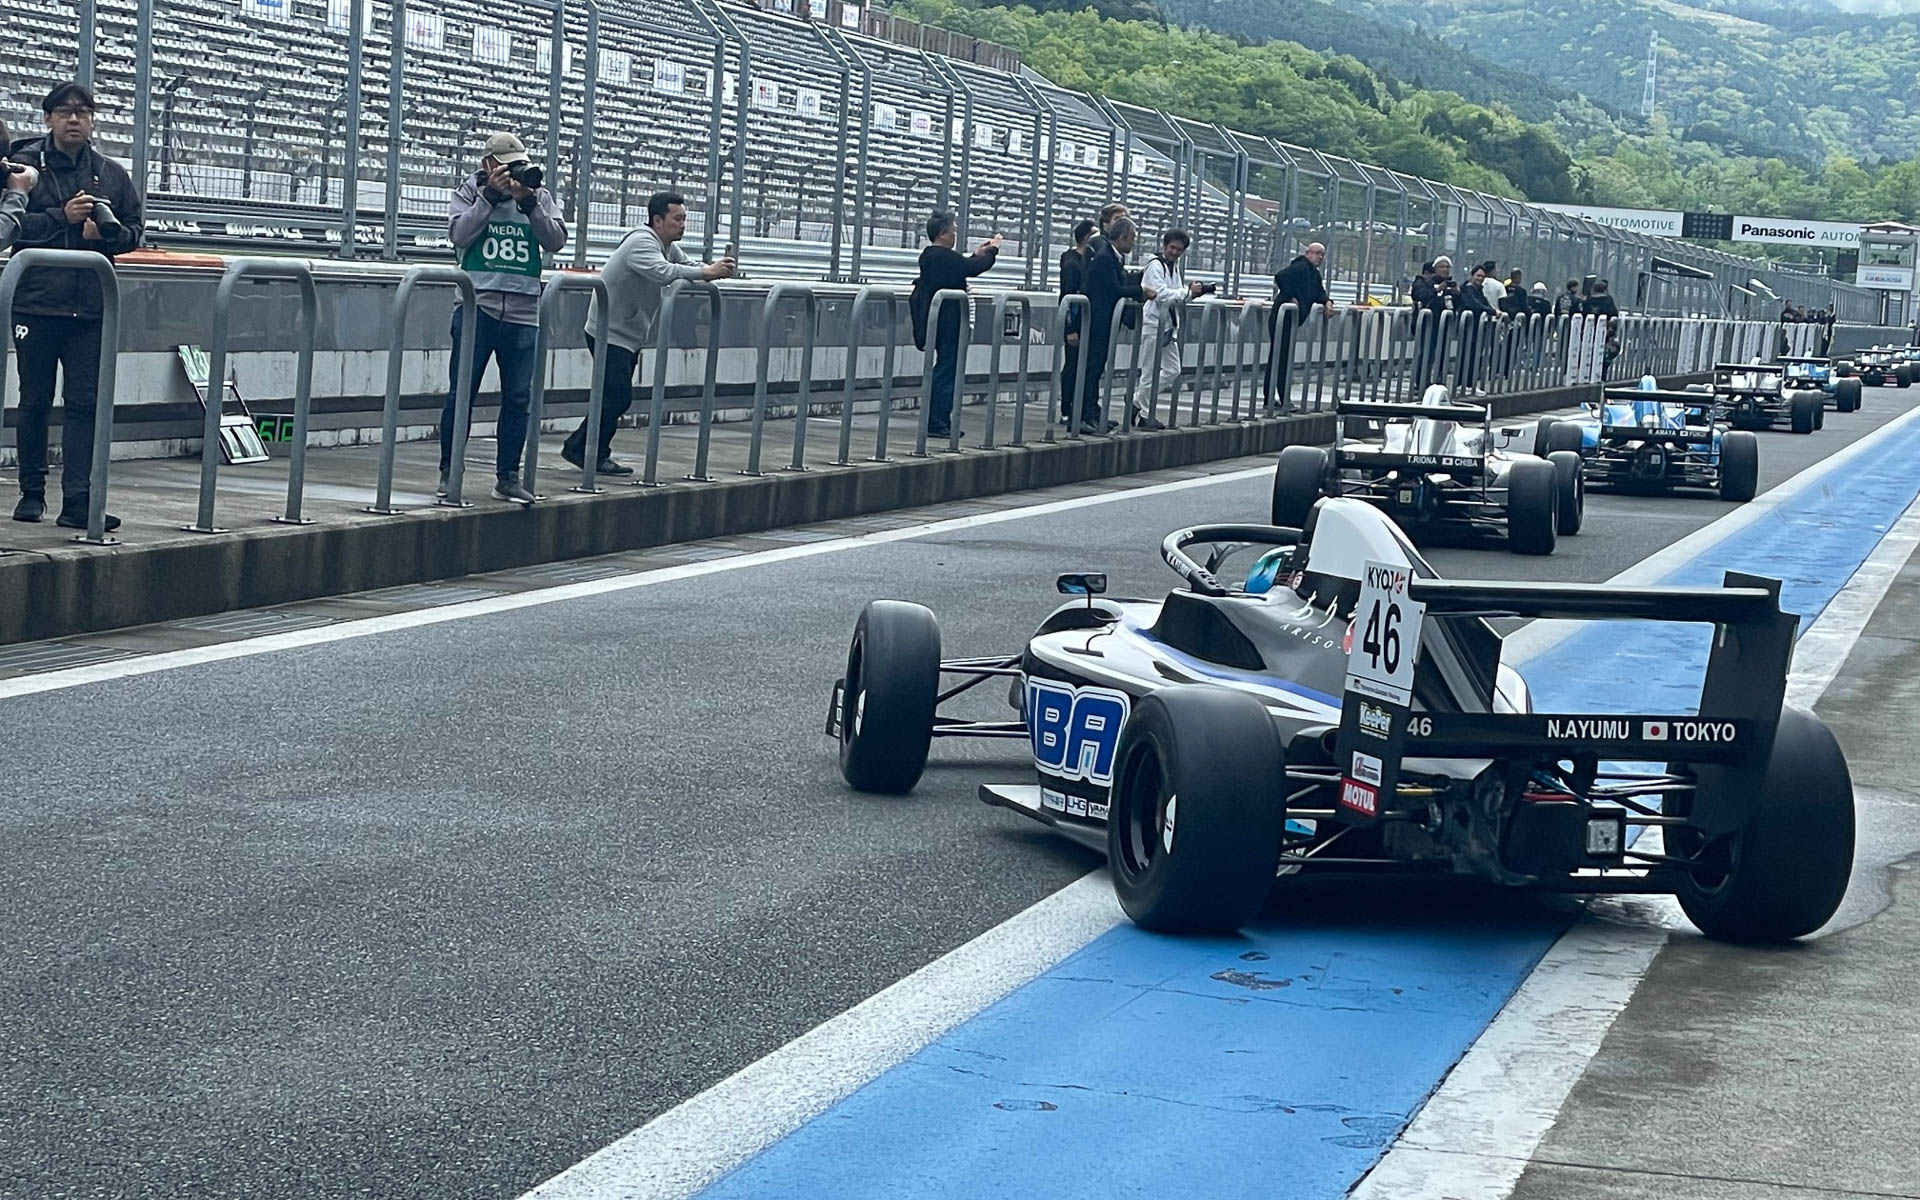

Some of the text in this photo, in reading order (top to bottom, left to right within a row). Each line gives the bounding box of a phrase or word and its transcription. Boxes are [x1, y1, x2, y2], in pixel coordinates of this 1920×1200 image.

[488, 223, 525, 237] MEDIA
[1597, 216, 1676, 230] AUTOMOTIVE
[1740, 223, 1816, 240] Panasonic
[482, 237, 530, 263] 085
[1407, 455, 1478, 467] T.RIONA CHIBA
[1362, 598, 1402, 675] 46
[1028, 676, 1131, 788] BA
[1406, 717, 1433, 737] 46
[1547, 719, 1736, 742] N.AYUMU TOKYO
[1342, 782, 1375, 812] MOTUL
